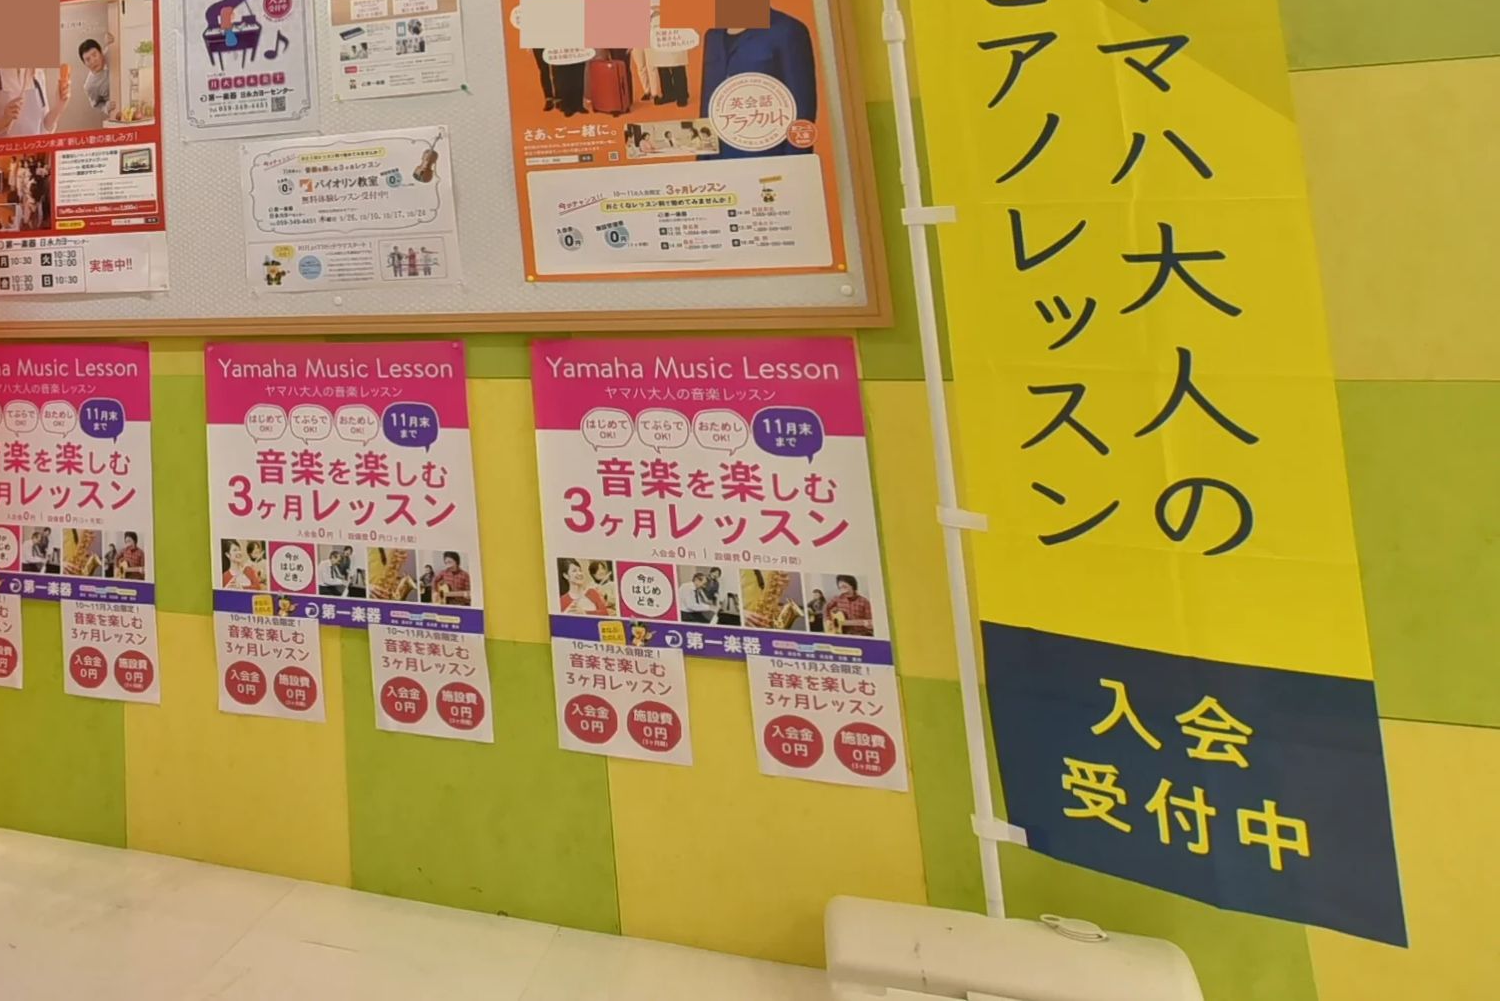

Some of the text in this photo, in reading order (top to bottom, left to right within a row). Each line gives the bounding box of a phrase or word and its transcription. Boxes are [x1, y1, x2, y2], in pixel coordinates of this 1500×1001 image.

[730, 94, 773, 109] 英会話
[719, 108, 790, 135] アラカルト
[666, 183, 726, 197] 3ヶ月レッスン
[11, 257, 32, 265] 10:30
[54, 250, 76, 258] 10:30
[54, 259, 77, 267] 13:00
[12, 275, 33, 283] 10:30
[55, 276, 78, 284] 10:30
[17, 359, 68, 376] Music
[75, 359, 138, 376] Lesson
[218, 358, 453, 378] Yamaha Music Lesson
[546, 356, 839, 380] Yamaha Music Lesson
[265, 385, 403, 398] ヤマハ大人の音楽レッスン
[604, 387, 776, 402] ヤマハ大人の音楽レッスン
[86, 408, 118, 421] 11月末
[390, 413, 430, 427] 11月末
[93, 422, 108, 431] まで
[400, 429, 417, 439] まで
[763, 418, 813, 436] 11月末
[775, 436, 796, 447] まで
[256, 449, 447, 489] 音楽を楽しむ
[597, 457, 837, 503] 音楽を楽しむ
[228, 475, 456, 527] 3ヶ月レッスン
[563, 486, 849, 548] 3ヶ月レッスン
[23, 579, 72, 597] 第一楽器
[637, 574, 655, 584] 今が
[632, 585, 661, 595] はじめ
[74, 612, 142, 629] 音楽を楽しむ
[322, 604, 382, 623] 第一楽器
[71, 628, 147, 646] 3ヶ月レッスン
[228, 625, 304, 644] 音楽を楽しむ
[687, 631, 762, 655] 第一楽器
[225, 642, 310, 661] 3ヶ月レッスン
[384, 639, 469, 659] 音楽を楽しむ
[382, 656, 476, 677] 3ヶ月レッスン
[569, 652, 666, 678] 音楽を楽しむ
[80, 669, 144, 683] 0円 0円
[566, 672, 672, 695] 3ヶ月レッスン
[767, 672, 876, 696] 音楽を楽しむ
[237, 685, 306, 701] 0円 0円
[395, 701, 472, 719] 0円 0円
[571, 703, 609, 720] 入会金
[764, 691, 884, 717] 3ヶ月レッスン
[580, 719, 668, 741] 0円 0円
[1091, 678, 1253, 768] 入会
[772, 725, 814, 742] 入会金
[781, 742, 880, 764] 0円 0円
[1061, 757, 1310, 871] 受付中
